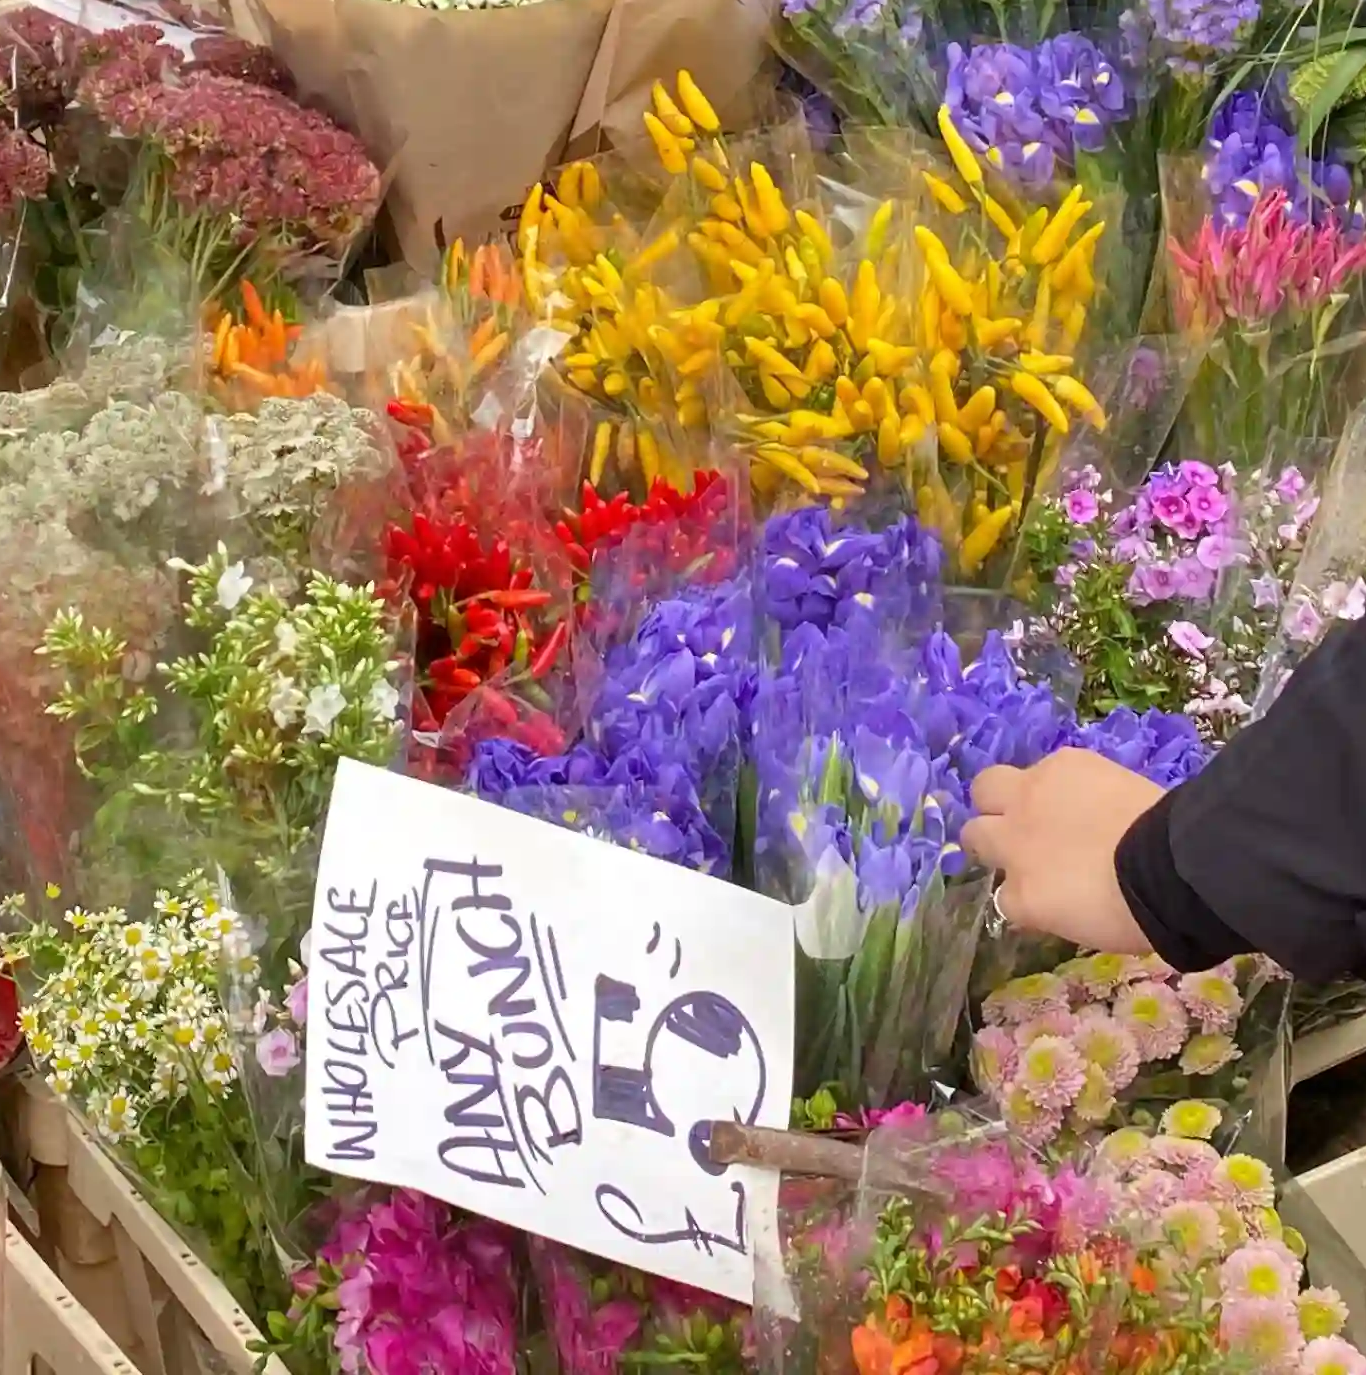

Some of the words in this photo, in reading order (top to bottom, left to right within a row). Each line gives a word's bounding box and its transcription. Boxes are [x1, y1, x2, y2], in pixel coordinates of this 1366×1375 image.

[320, 877, 379, 1162] WHOLESALE
[368, 891, 421, 1069] PRICE
[423, 855, 583, 1166] BUNCH
[435, 1018, 526, 1190] ANY
